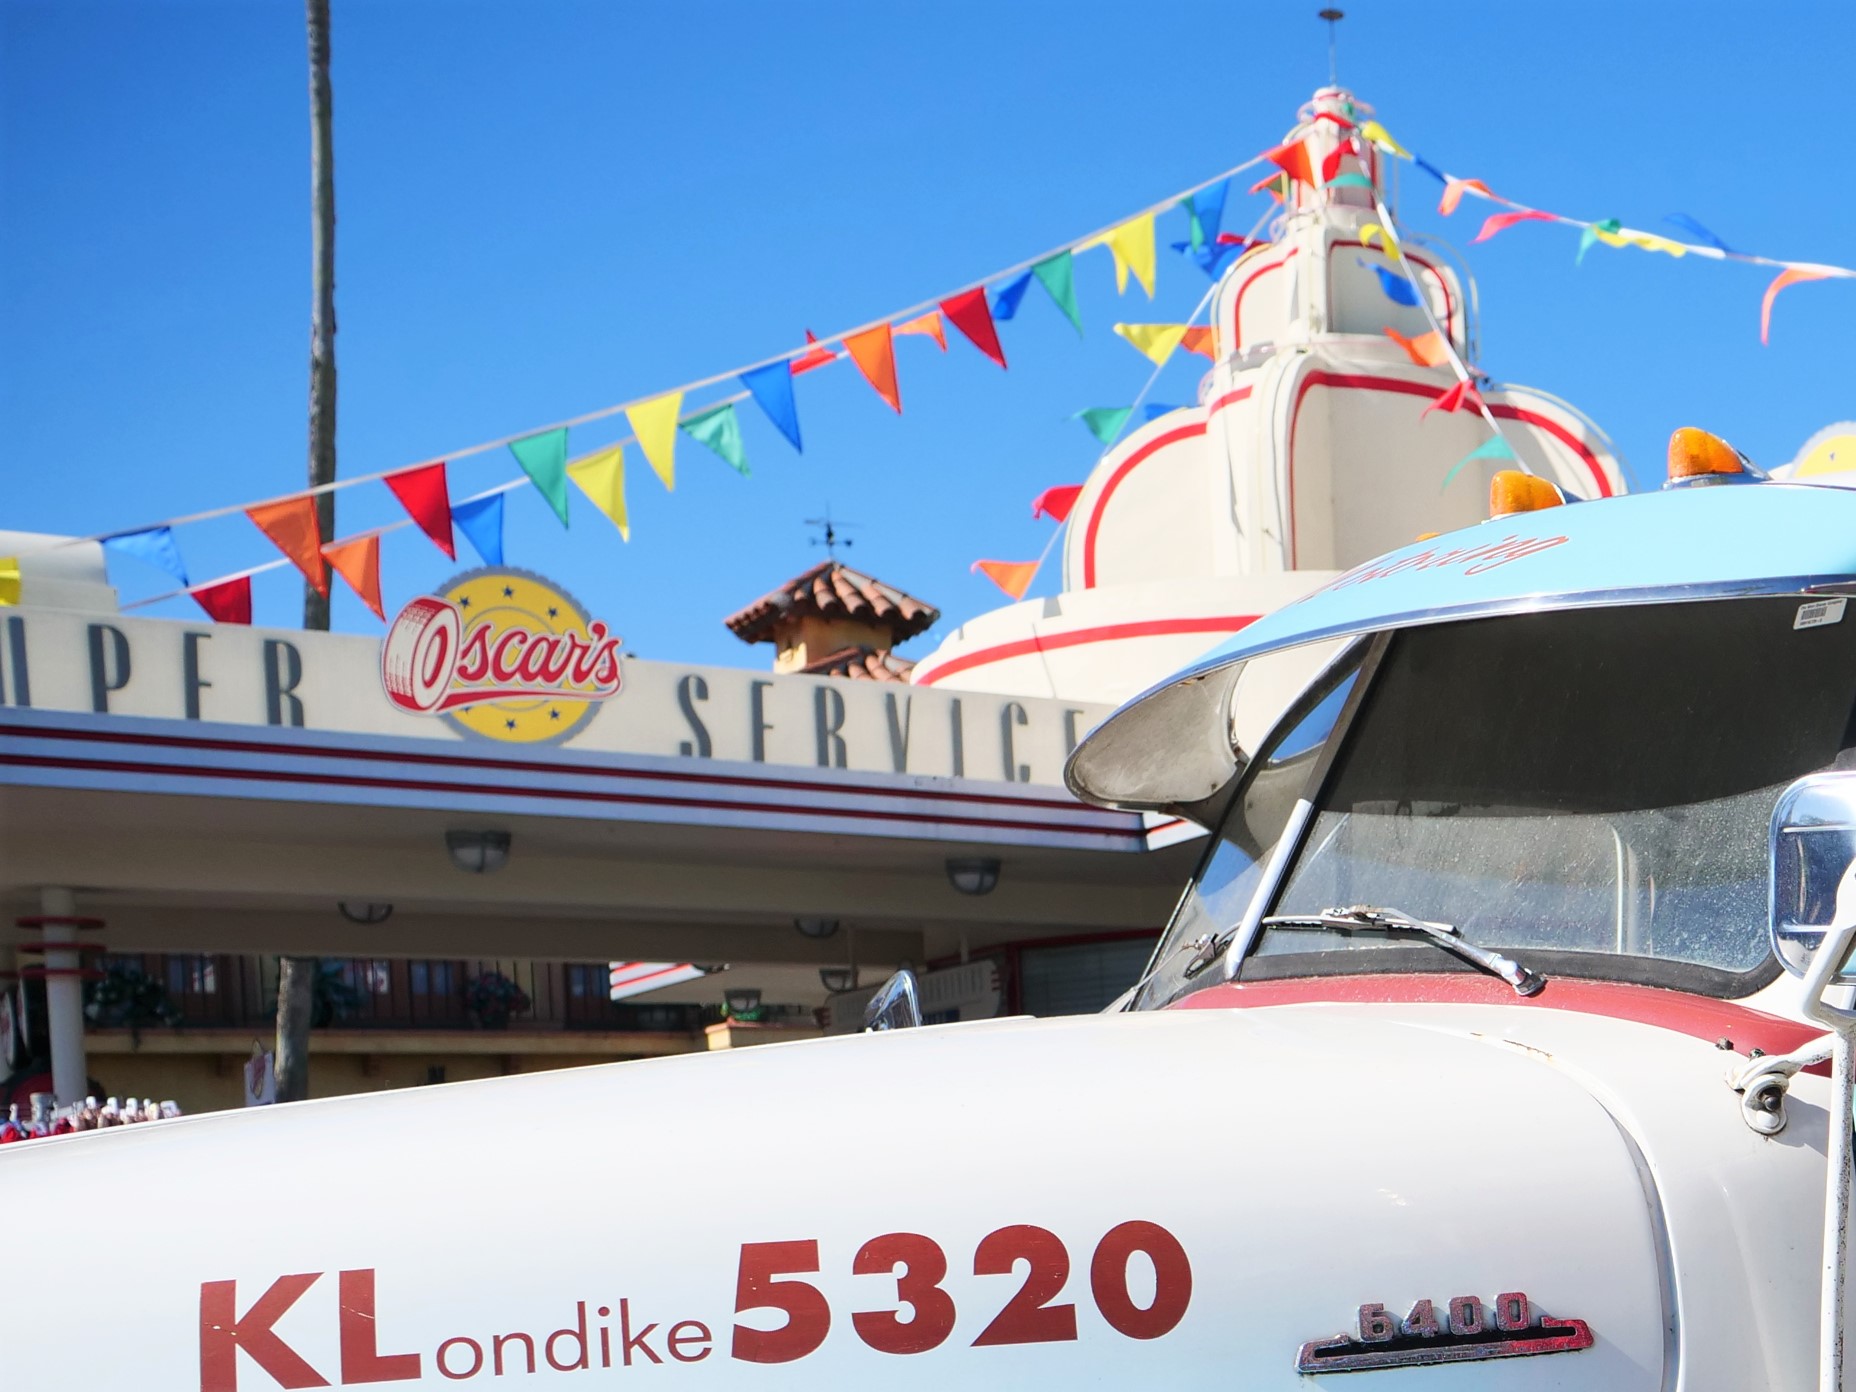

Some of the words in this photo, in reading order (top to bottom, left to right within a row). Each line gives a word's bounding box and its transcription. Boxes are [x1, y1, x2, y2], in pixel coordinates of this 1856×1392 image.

[382, 596, 624, 716] Oscar's
[732, 1220, 1192, 1363] 5320
[1357, 1291, 1531, 1343] 6400
